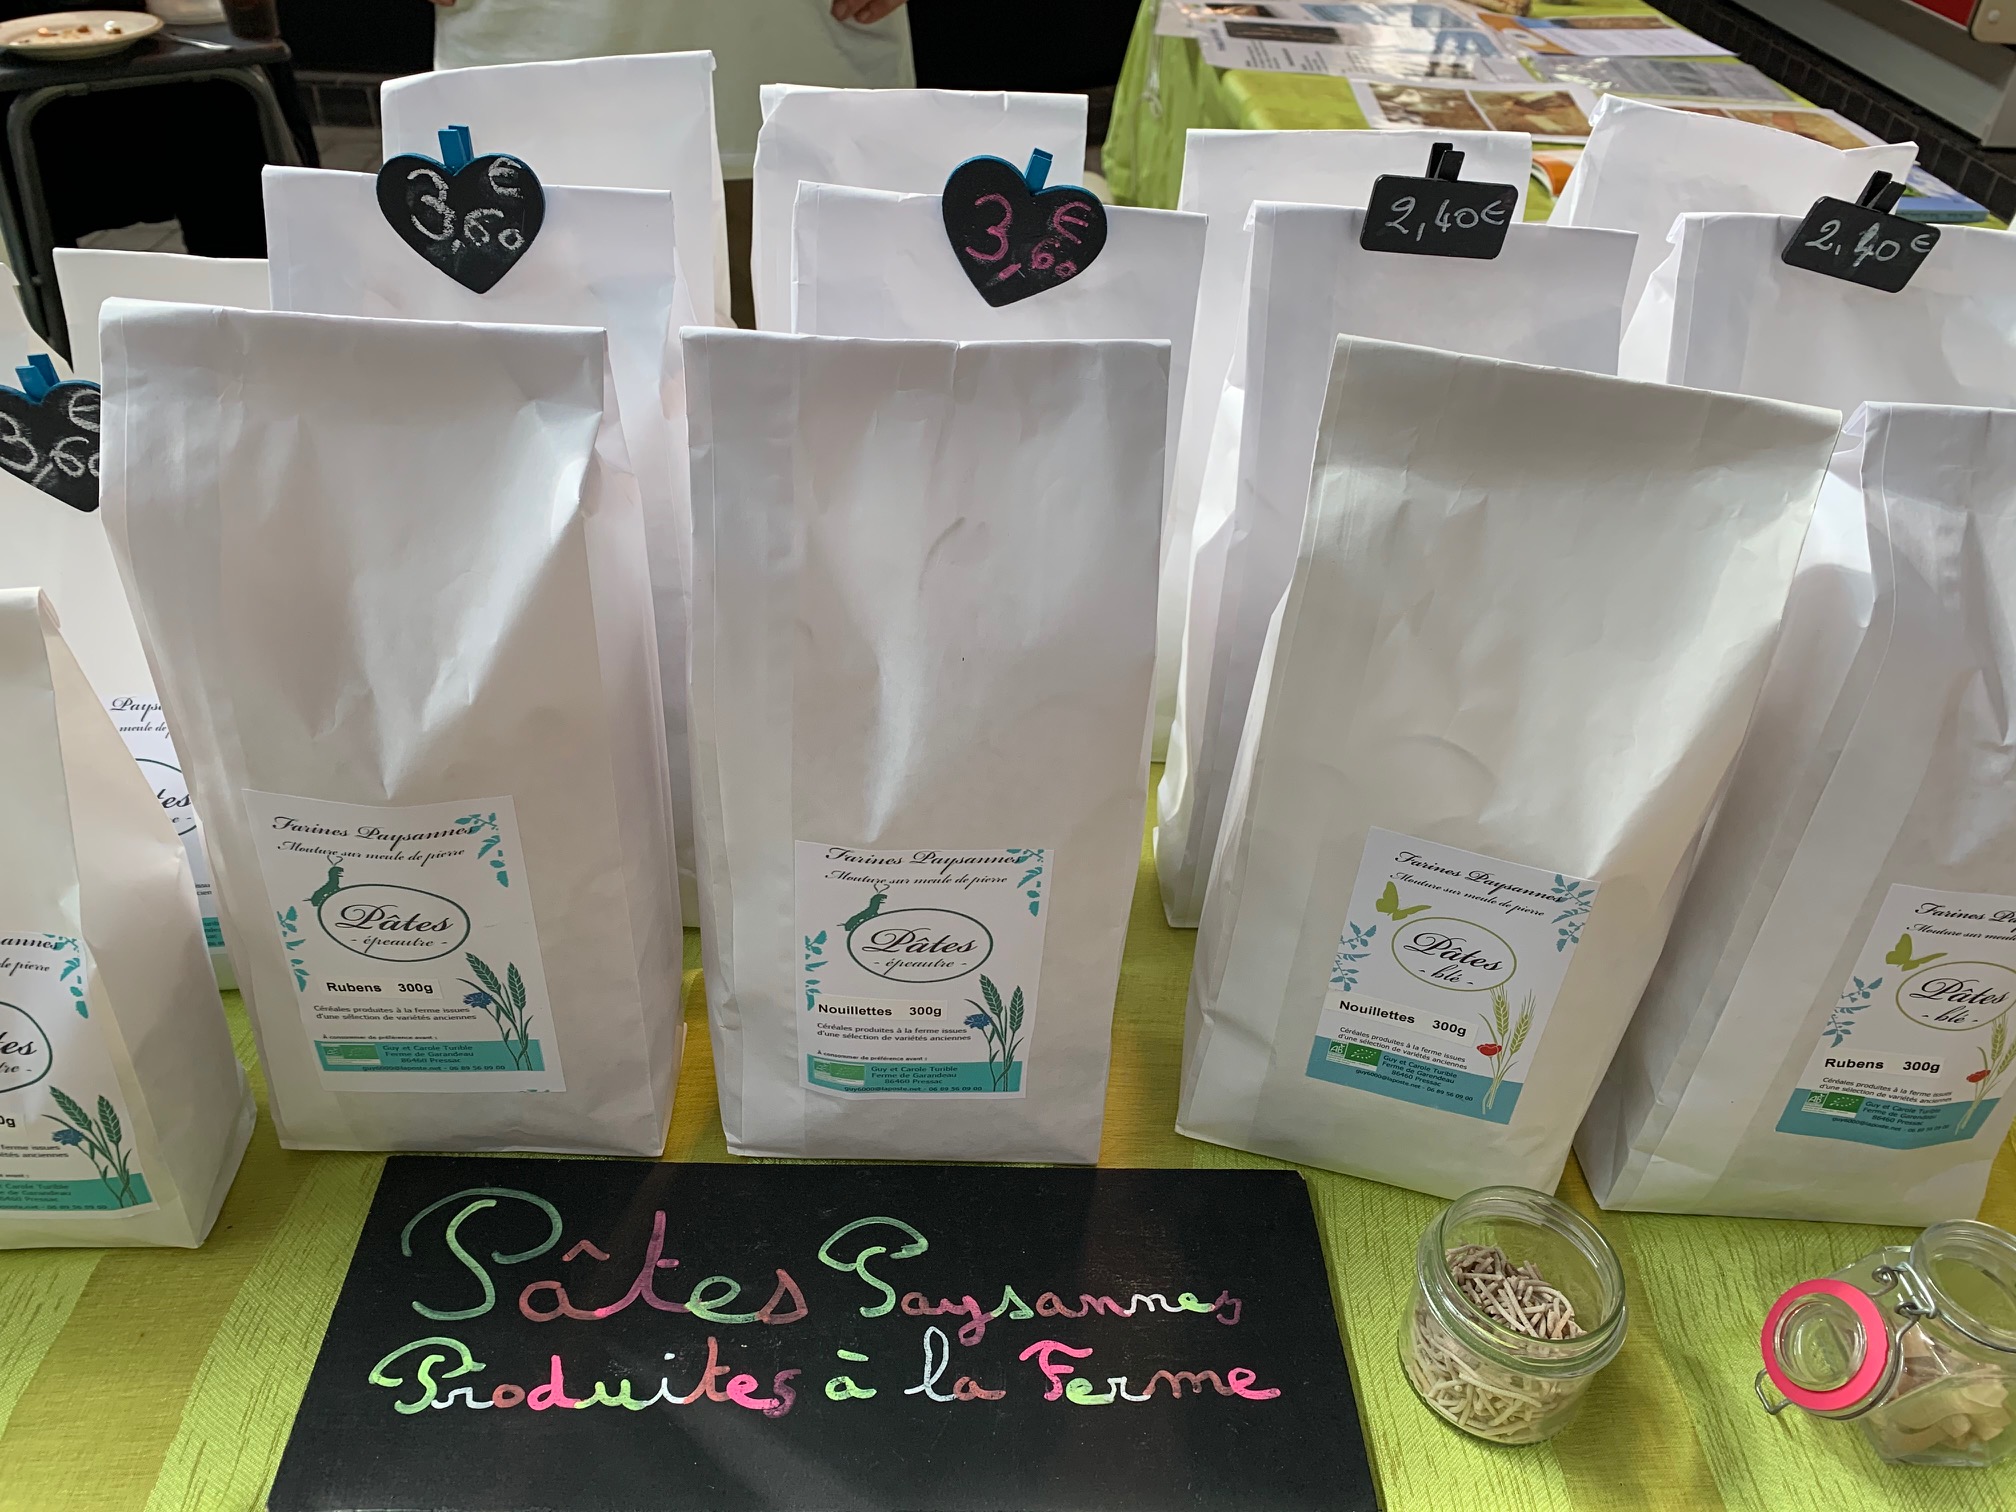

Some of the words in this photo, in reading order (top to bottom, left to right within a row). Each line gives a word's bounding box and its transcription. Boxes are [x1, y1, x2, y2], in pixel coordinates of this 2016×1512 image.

[272, 816, 348, 837] Farines
[356, 826, 474, 851] Paysannes
[278, 841, 338, 855] Mouture
[340, 850, 361, 858] sur
[366, 850, 404, 861] meule
[408, 850, 423, 861] de
[421, 849, 465, 867] pierre
[825, 847, 903, 865] Farines
[909, 850, 1023, 875] Paysannes
[825, 870, 886, 884] Mouture
[889, 877, 910, 885] sur
[914, 874, 952, 885] meule
[954, 874, 970, 885] de
[964, 875, 1008, 890] pierre
[1395, 851, 1462, 877] Farines
[1465, 870, 1565, 903] Paysannes
[1389, 872, 1442, 890] Mouture
[1443, 887, 1462, 896] sur
[1464, 893, 1497, 905] meule
[1498, 899, 1512, 909] de
[1506, 904, 1544, 917] pierre
[335, 904, 454, 932] Pâtes
[1915, 902, 1985, 920] Farines
[1906, 923, 1962, 936] Mouture
[861, 927, 978, 954] Pâtes
[1403, 932, 1503, 971] Pâtes
[9, 961, 50, 976] pierre
[326, 982, 382, 993] Rubens
[398, 983, 434, 994] 300g
[1909, 978, 2010, 1004] Pâtes
[313, 1005, 350, 1013] Céréales
[353, 1006, 394, 1015] produites
[342, 1013, 381, 1021] sélection
[818, 1003, 893, 1016] Nouillettes
[909, 1006, 942, 1017] 300g
[1339, 1000, 1415, 1024] Nouillettes
[1432, 1020, 1467, 1038] 300g
[817, 1022, 853, 1032] Céréales
[855, 1026, 894, 1035] produites
[817, 1030, 840, 1038] d'une
[842, 1033, 879, 1041] sélection
[1338, 1034, 1358, 1043] d'une
[1359, 1038, 1390, 1051] sélection
[1391, 1044, 1401, 1052] de
[1402, 1048, 1430, 1061] variétés
[1432, 1057, 1468, 1070] anciennes
[1340, 1027, 1370, 1039] Céréales
[1371, 1035, 1404, 1047] produites
[1421, 1046, 1442, 1057] ferme
[1443, 1052, 1466, 1063] issues
[1382, 1061, 1405, 1071] Ferme
[1383, 1055, 1398, 1064] Guy
[1408, 1061, 1431, 1072] Carole
[1824, 1058, 1884, 1069] Rubens
[1903, 1061, 1940, 1074] 300g
[1415, 1076, 1441, 1087] Pressac
[1822, 1077, 1854, 1086] Céréales
[1856, 1081, 1891, 1093] produites
[1909, 1089, 1931, 1097] ferme
[1842, 1086, 1875, 1096] sélection
[1888, 1094, 1917, 1103] variétés
[1862, 1107, 1887, 1116] Ferme
[1865, 1101, 1880, 1109] Guy
[1892, 1105, 1917, 1114] Carole
[400, 1187, 808, 1325] Pâtes
[817, 1216, 1242, 1346] Paysannes
[368, 1337, 802, 1418] Produites
[824, 1348, 877, 1401] à
[903, 1325, 1006, 1402] la
[1018, 1339, 1281, 1406] Ferme
